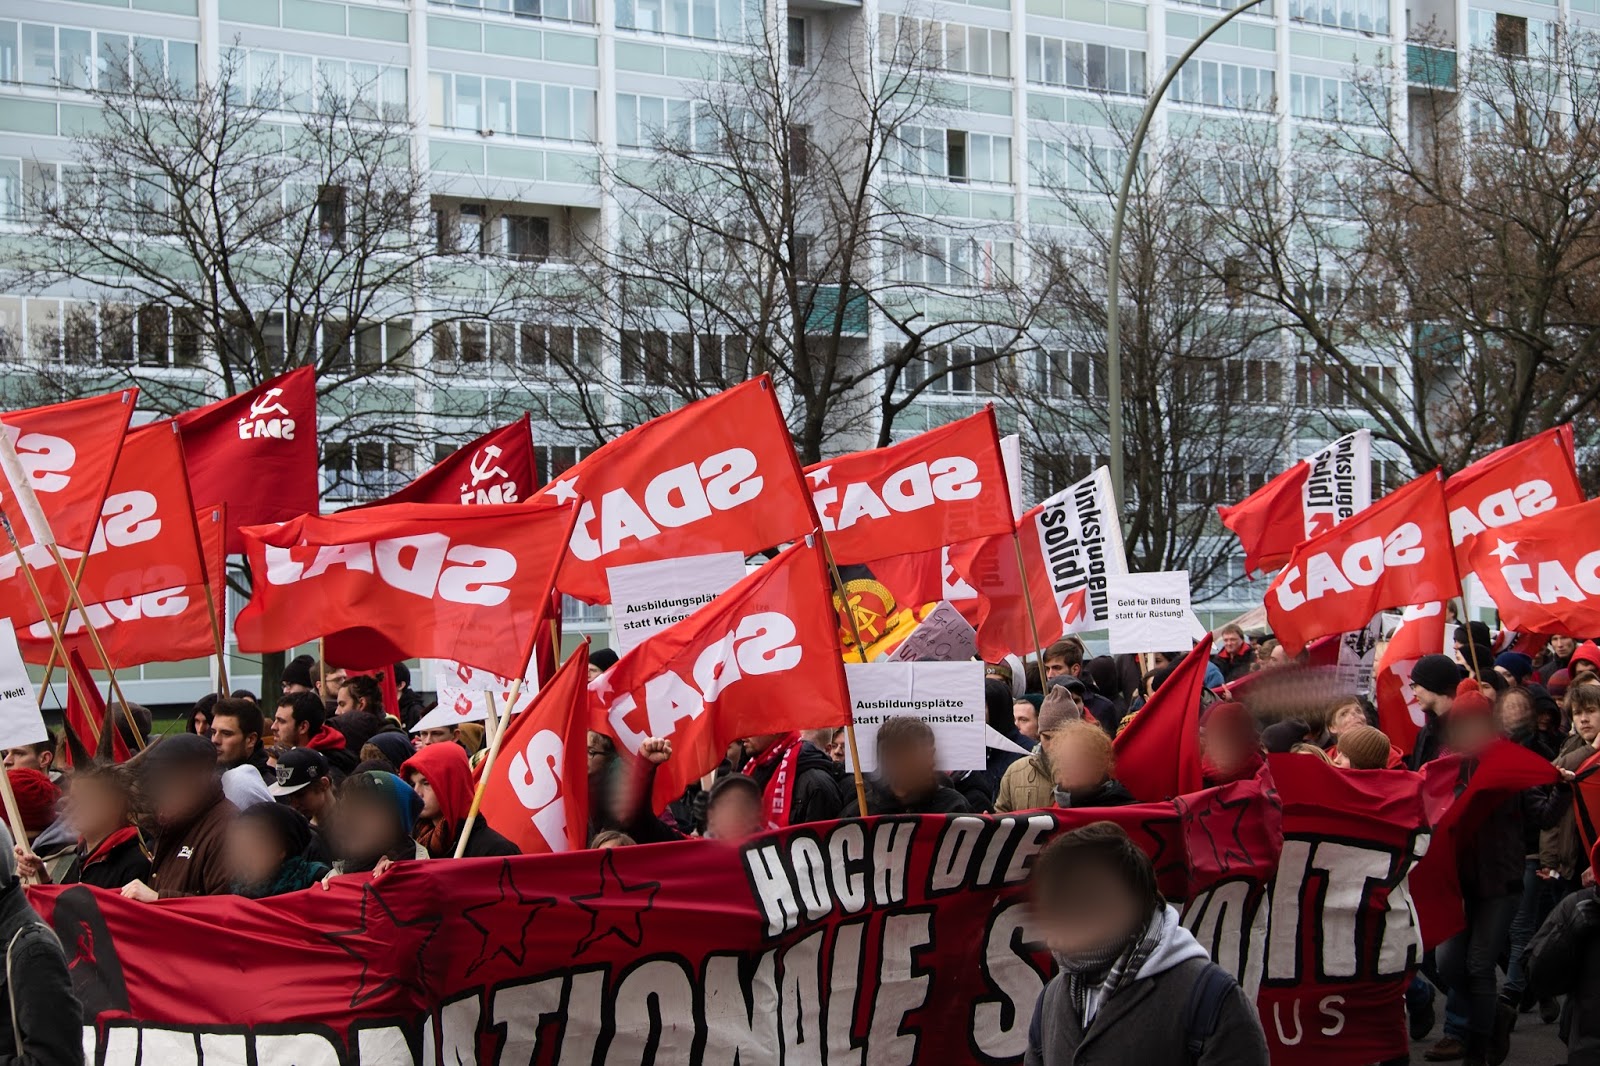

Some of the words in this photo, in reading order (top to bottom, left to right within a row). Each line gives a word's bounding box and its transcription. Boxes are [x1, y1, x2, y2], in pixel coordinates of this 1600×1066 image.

[1117, 599, 1136, 607] Geld
[1150, 597, 1181, 606] Bildung
[1115, 612, 1134, 620] statt
[1135, 611, 1147, 619] für
[1149, 609, 1184, 619] Rüstung!
[623, 619, 651, 631] statt
[3, 687, 26, 699] Welt!
[856, 698, 964, 710] Ausbildungsplätze
[853, 715, 879, 725] statt
[745, 821, 916, 938] HOCH
[931, 815, 1055, 892] DIE
